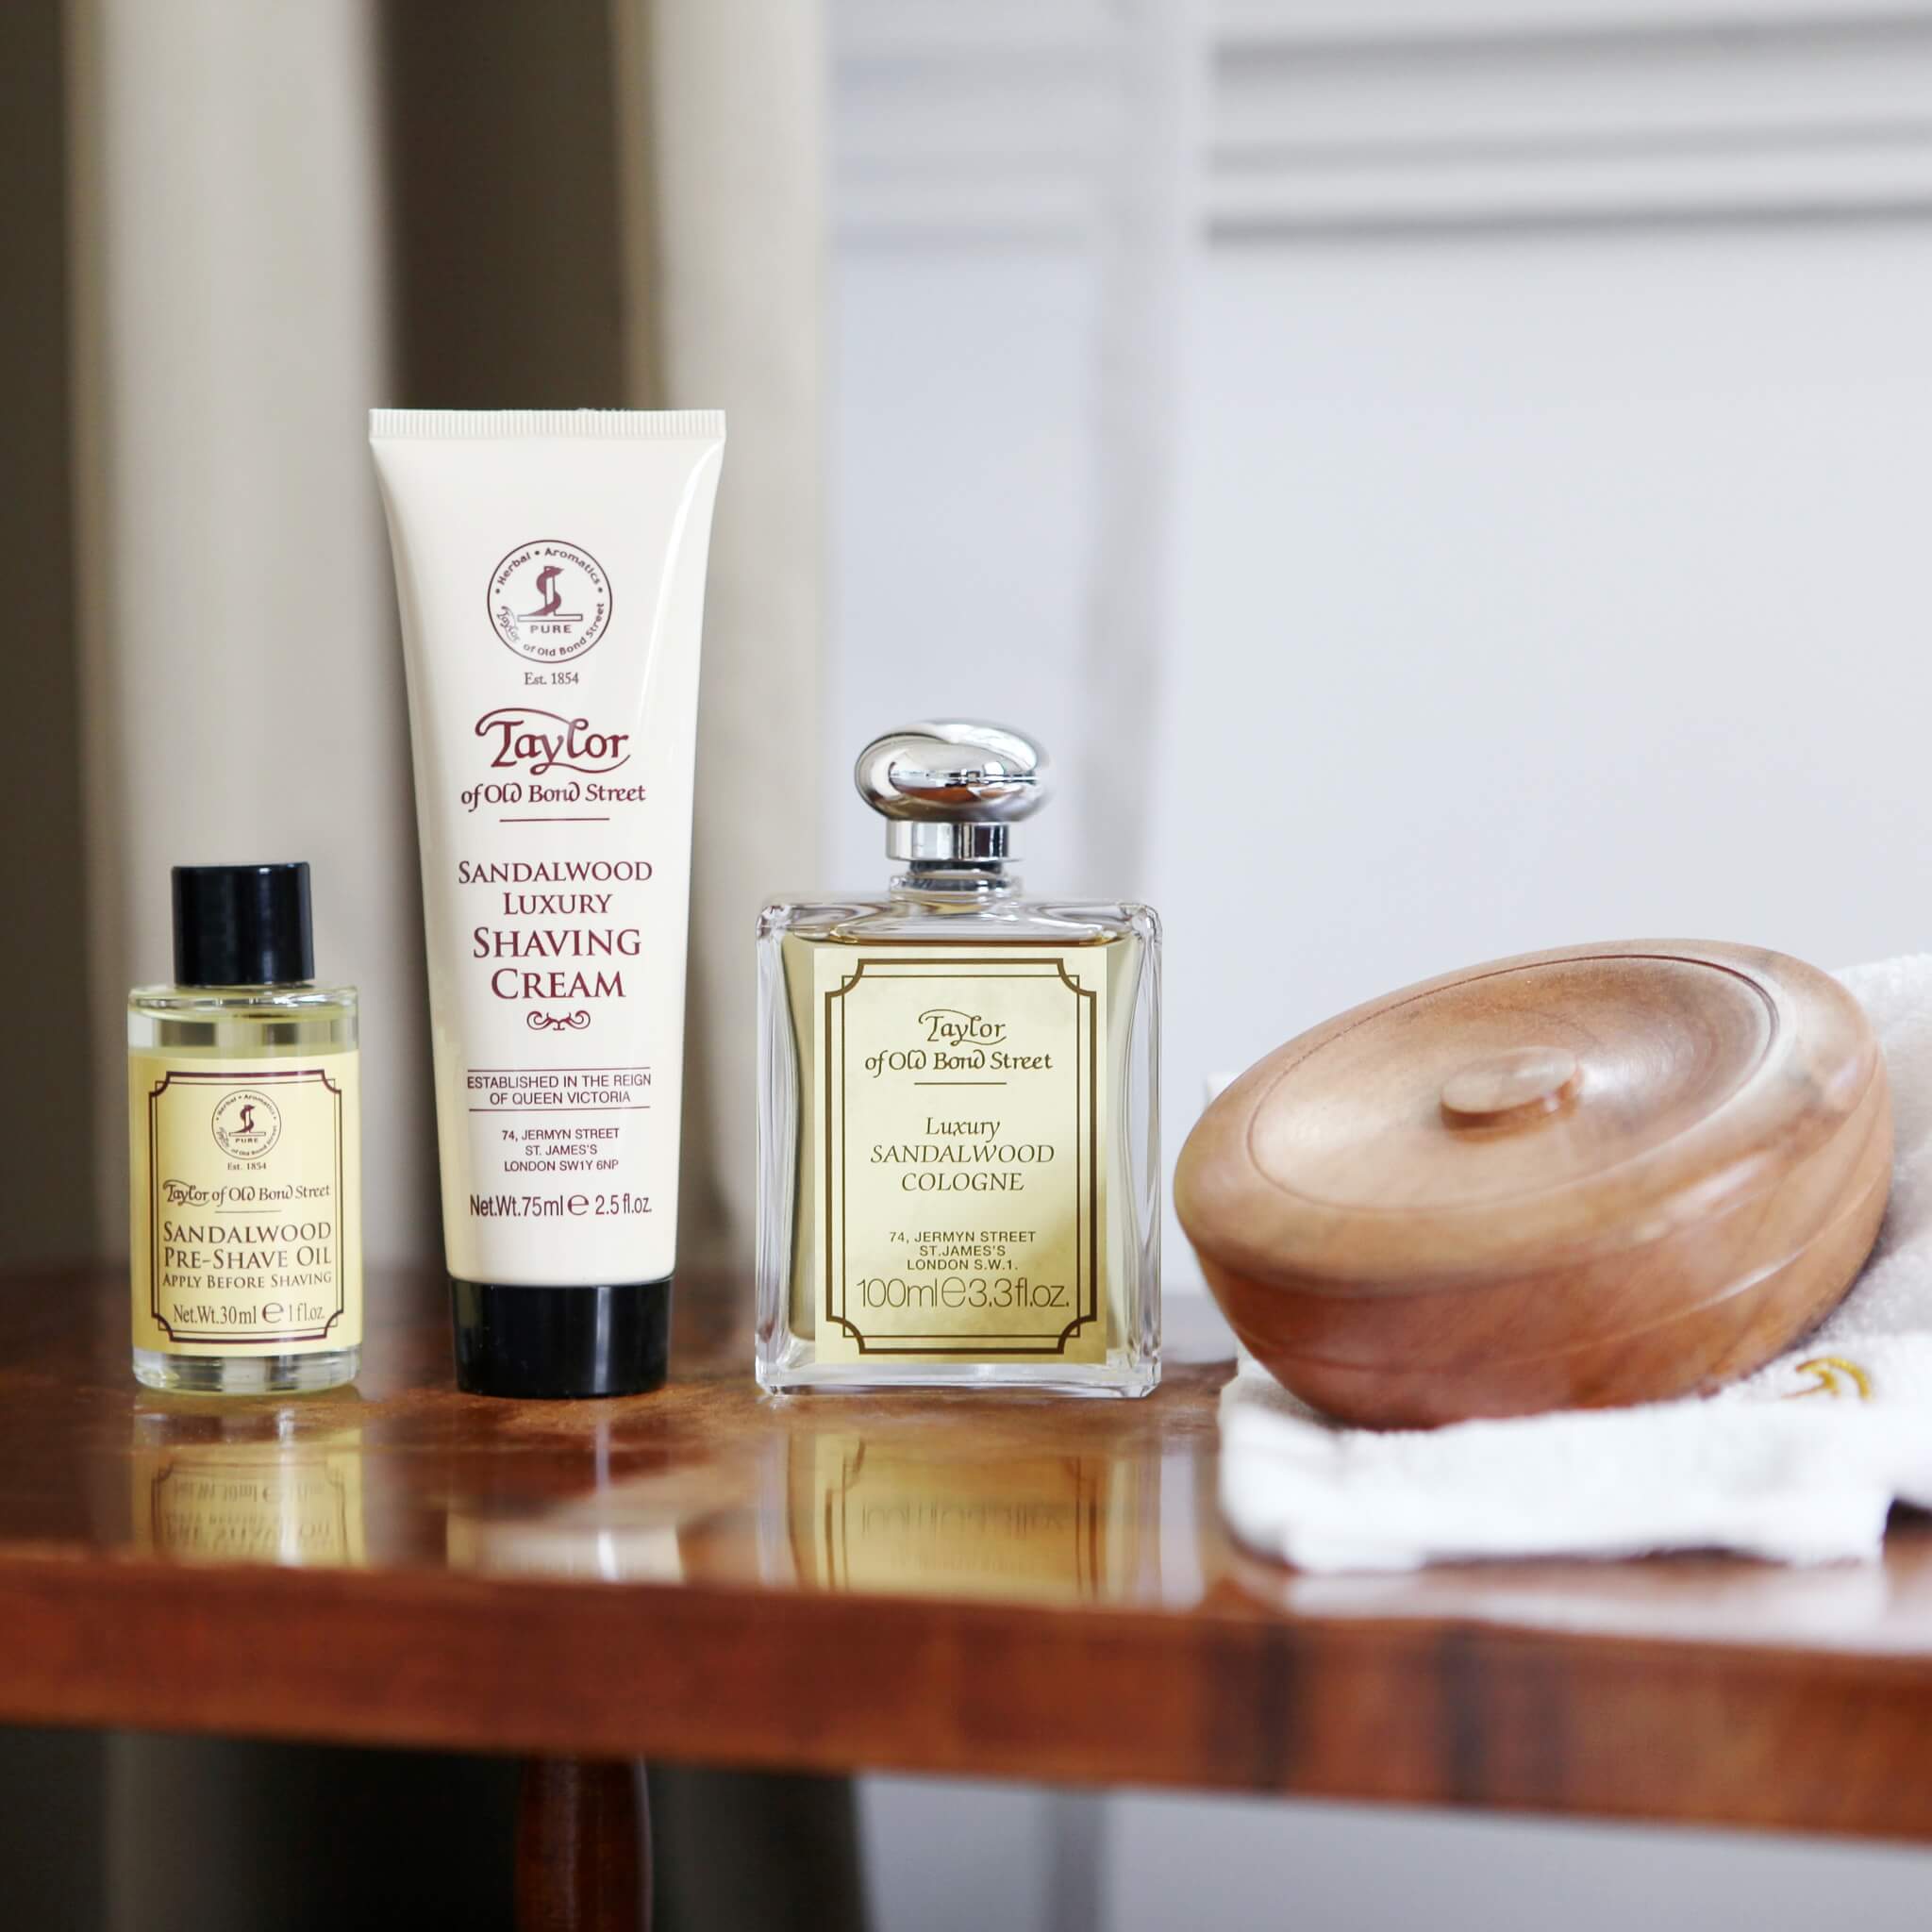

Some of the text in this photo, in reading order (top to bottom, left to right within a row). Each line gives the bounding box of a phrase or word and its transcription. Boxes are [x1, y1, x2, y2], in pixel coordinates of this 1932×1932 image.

[497, 547, 600, 585] Herbal Aromatics
[524, 643, 536, 652] of
[538, 648, 556, 657] Old
[559, 637, 587, 655] Bond
[586, 603, 605, 639] Street
[530, 625, 572, 634] PURE
[525, 672, 579, 685] Est. 1854
[475, 708, 631, 775] Taylor
[460, 782, 646, 812] of Old Bond Street
[458, 860, 653, 884] SANDALWOOD
[503, 892, 613, 915] LUXURY
[474, 926, 641, 958] SHAVING
[491, 968, 626, 999] CREAM
[919, 1009, 1007, 1046] Taylor
[865, 1049, 1053, 1078] of Old Bond Street
[467, 1074, 651, 1089] ESTABLISHED IN THE REIGN
[490, 1091, 630, 1105] OF QUEEN VICTORIA
[502, 1128, 619, 1141] 74, JERMYN STREET
[925, 1117, 1000, 1142] Luxury
[525, 1144, 597, 1156] ST. JAMES'S
[871, 1144, 1055, 1163] SANDALWOOD
[505, 1159, 619, 1172] LONDON SW1Y 6NP
[163, 1179, 330, 1207] Taylor of Old Bond Street
[902, 1173, 1024, 1191] COLOGNE
[595, 1194, 619, 1215] 2.5
[163, 1221, 331, 1243] SANDALWOOD
[890, 1231, 1036, 1243] 74, JERMYN STREET
[165, 1246, 331, 1270] PRE-SHAVE OIL
[908, 1259, 1018, 1270] LONDON S.W.1.
[162, 1273, 331, 1289] APPLY BEFORE SHAVING
